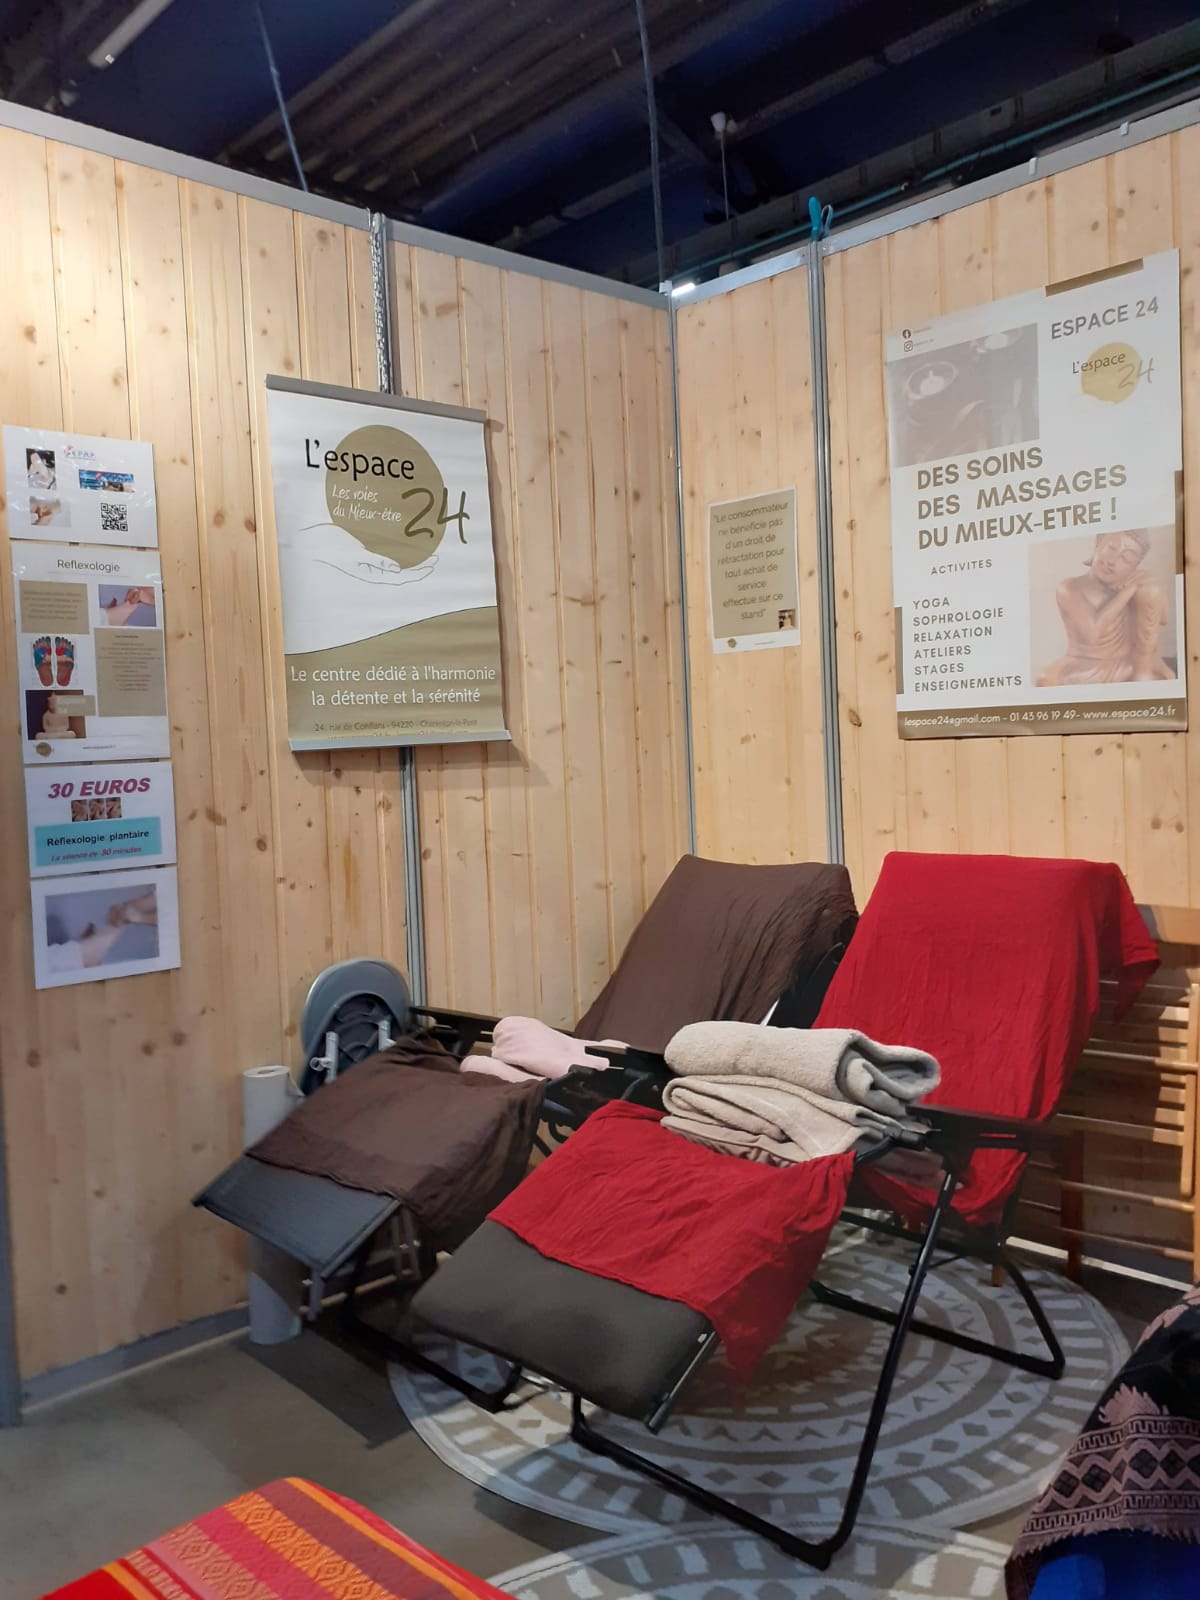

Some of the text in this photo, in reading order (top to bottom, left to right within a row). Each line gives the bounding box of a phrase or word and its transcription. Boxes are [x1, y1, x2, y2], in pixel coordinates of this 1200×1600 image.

[1050, 296, 1160, 340] ESPACE 24
[1072, 352, 1126, 374] L'espace
[1118, 357, 1155, 390] 24
[305, 438, 415, 482] L'espace
[917, 447, 1043, 490] DES SOINS
[332, 483, 350, 500] Les
[918, 464, 1127, 520] DES MASSAGES
[333, 500, 345, 517] du
[401, 487, 470, 544] 24
[728, 502, 789, 521] consommateur
[769, 518, 784, 530] pas
[918, 497, 1117, 550] DU MIEUX-ETRE !
[745, 536, 764, 546] droit
[765, 533, 776, 543] de
[766, 548, 785, 560] pour
[724, 563, 778, 579] tout achat de
[930, 558, 993, 575] ACTIVITES
[912, 597, 950, 610] YOGA
[913, 607, 1004, 627] SOPHROLOGIE
[913, 626, 993, 643] RELAXATION
[914, 645, 972, 660] ATELIERS
[290, 665, 497, 682] Le centre dédié à l'harmonie
[914, 662, 965, 676] STAGES
[915, 675, 1023, 693] ENSEIGNEMENTS
[311, 688, 481, 707] la détente et la sérénité
[1009, 712, 1020, 722] 01
[1022, 711, 1035, 722] 43
[1036, 711, 1049, 721] 96
[1051, 710, 1061, 721] 19
[1083, 705, 1177, 721] www.espace24.fr
[48, 777, 152, 799] 30 EUROS
[109, 830, 150, 842] plantaire
